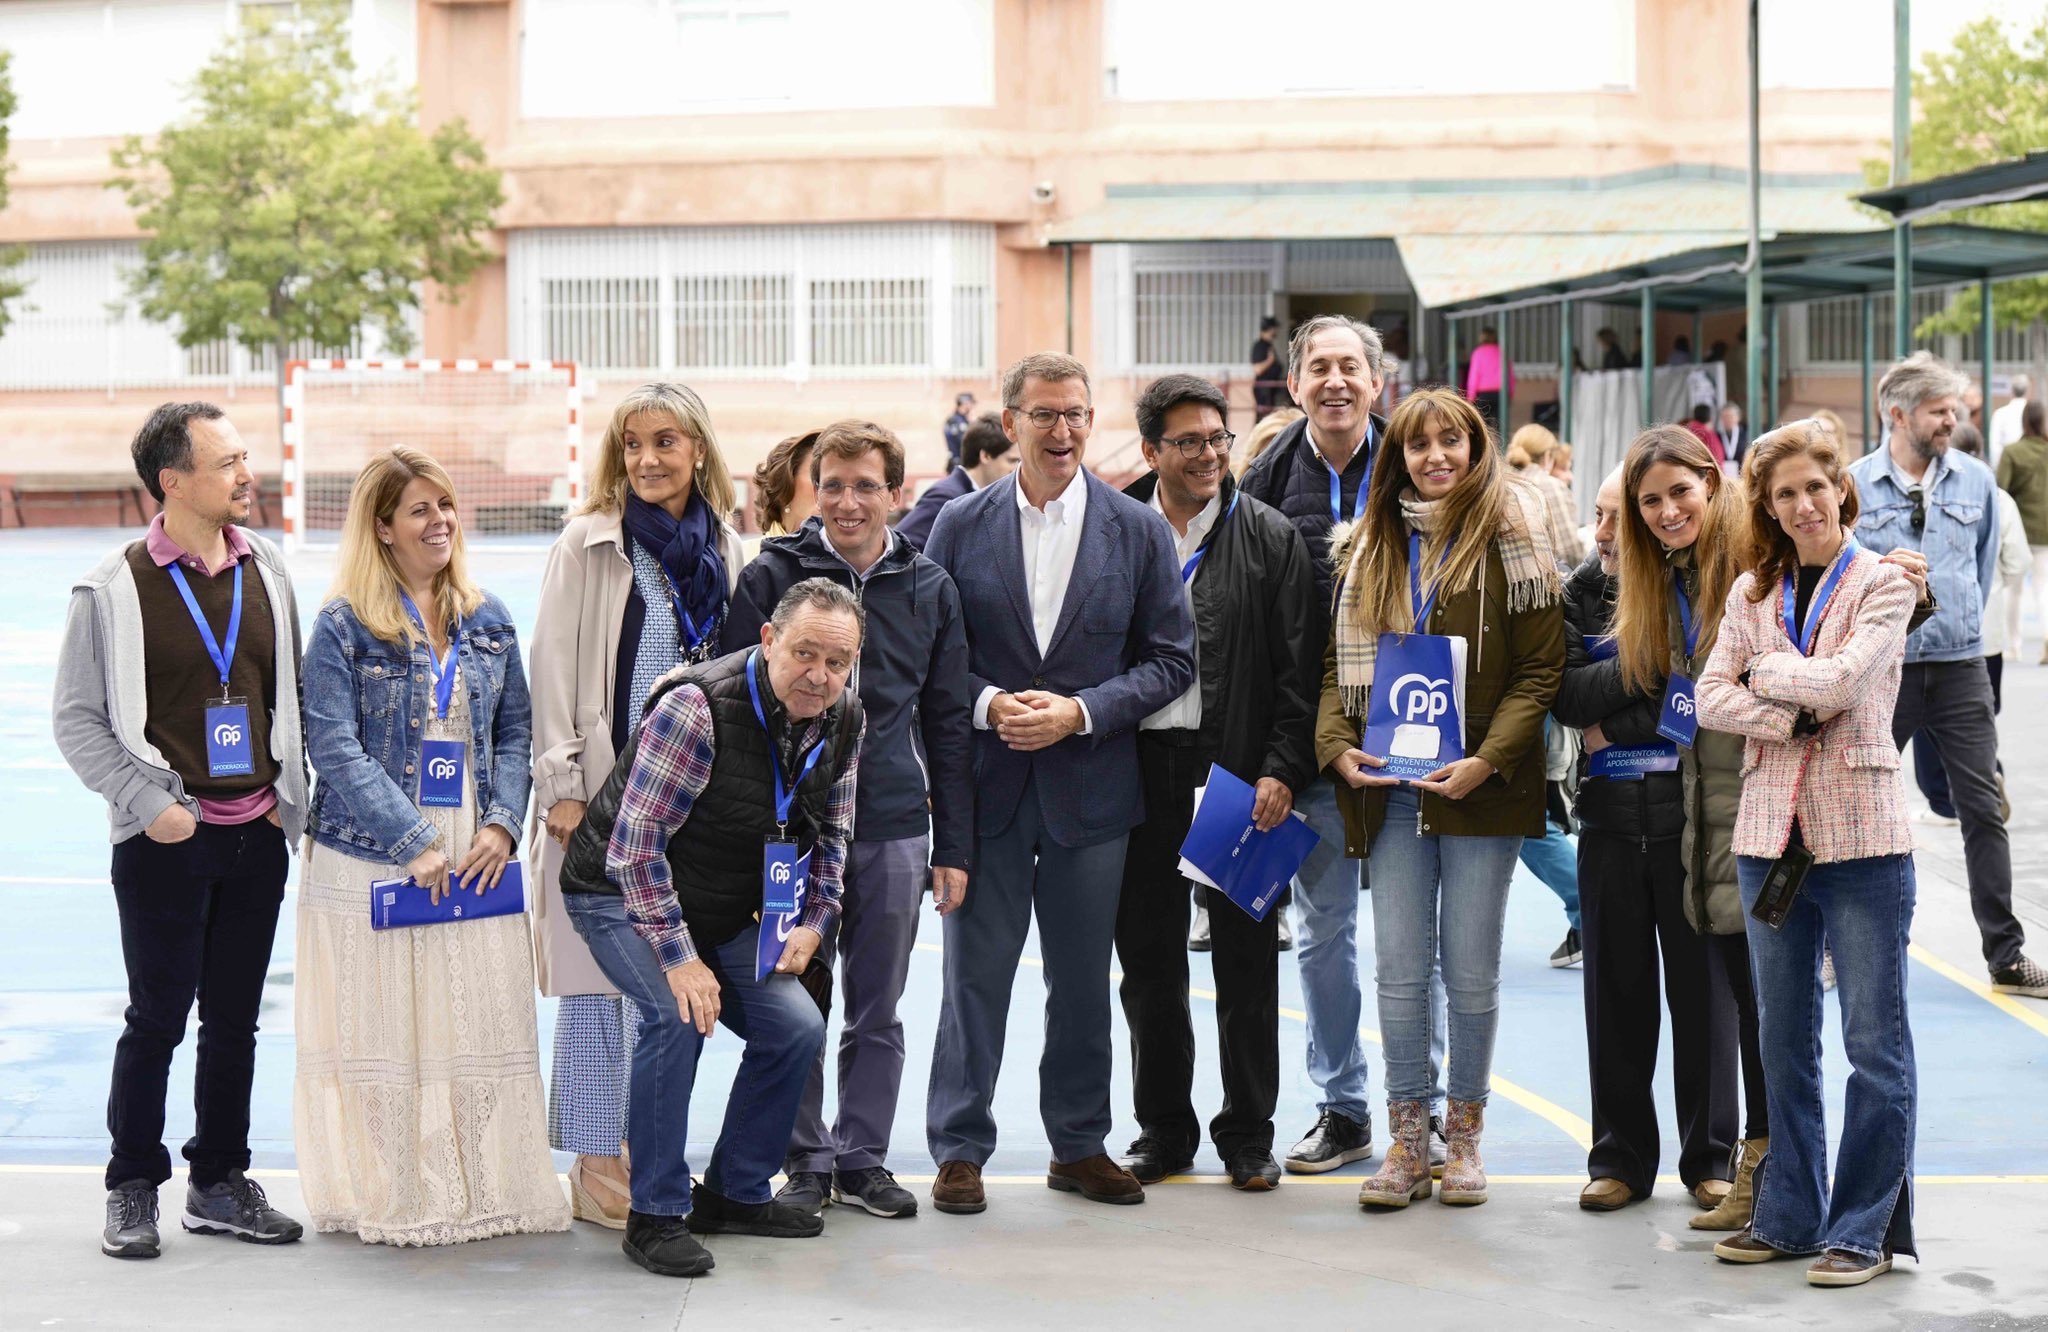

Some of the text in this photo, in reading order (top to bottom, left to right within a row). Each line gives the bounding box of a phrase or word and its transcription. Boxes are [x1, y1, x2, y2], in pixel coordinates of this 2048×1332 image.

[1607, 750, 1666, 759] INTERVENTOR/A
[212, 763, 250, 771] APODERADO/A
[1606, 758, 1658, 768] APODERADO/A
